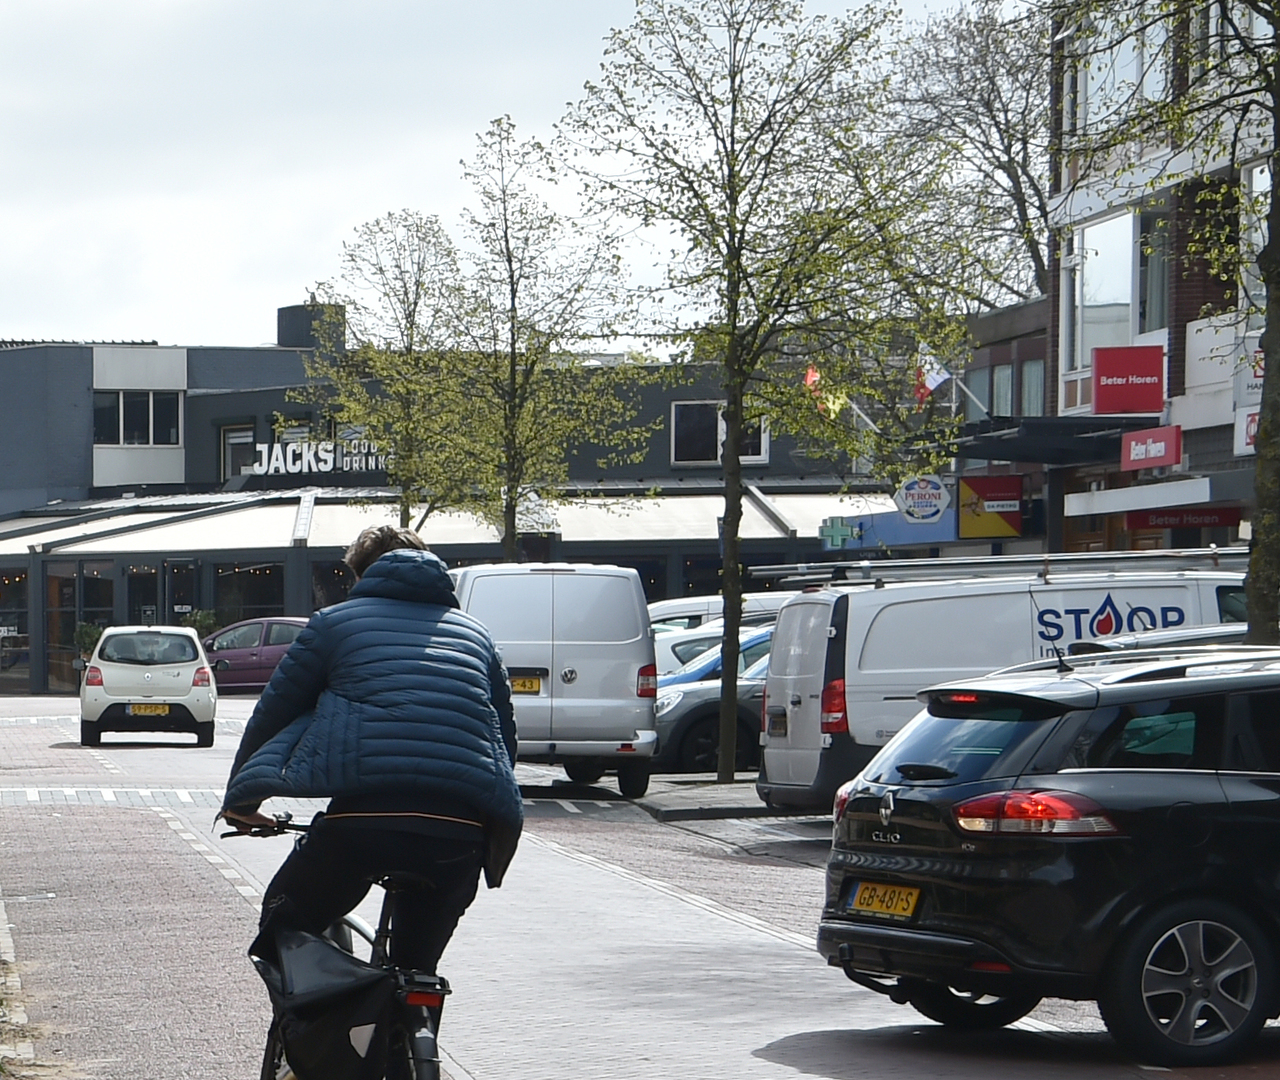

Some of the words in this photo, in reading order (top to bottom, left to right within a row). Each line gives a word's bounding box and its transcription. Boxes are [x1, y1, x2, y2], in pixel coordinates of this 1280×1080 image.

[1100, 375, 1126, 385] Beter
[1129, 374, 1158, 385] Horen
[1130, 440, 1146, 461] Beter
[1147, 438, 1166, 458] Horen
[253, 441, 335, 475] JACKS
[905, 492, 941, 500] PERONI
[1149, 515, 1180, 525] Beter
[1183, 513, 1219, 524] Horen
[872, 831, 901, 844] CLIO
[859, 886, 913, 912] GB-481-S
